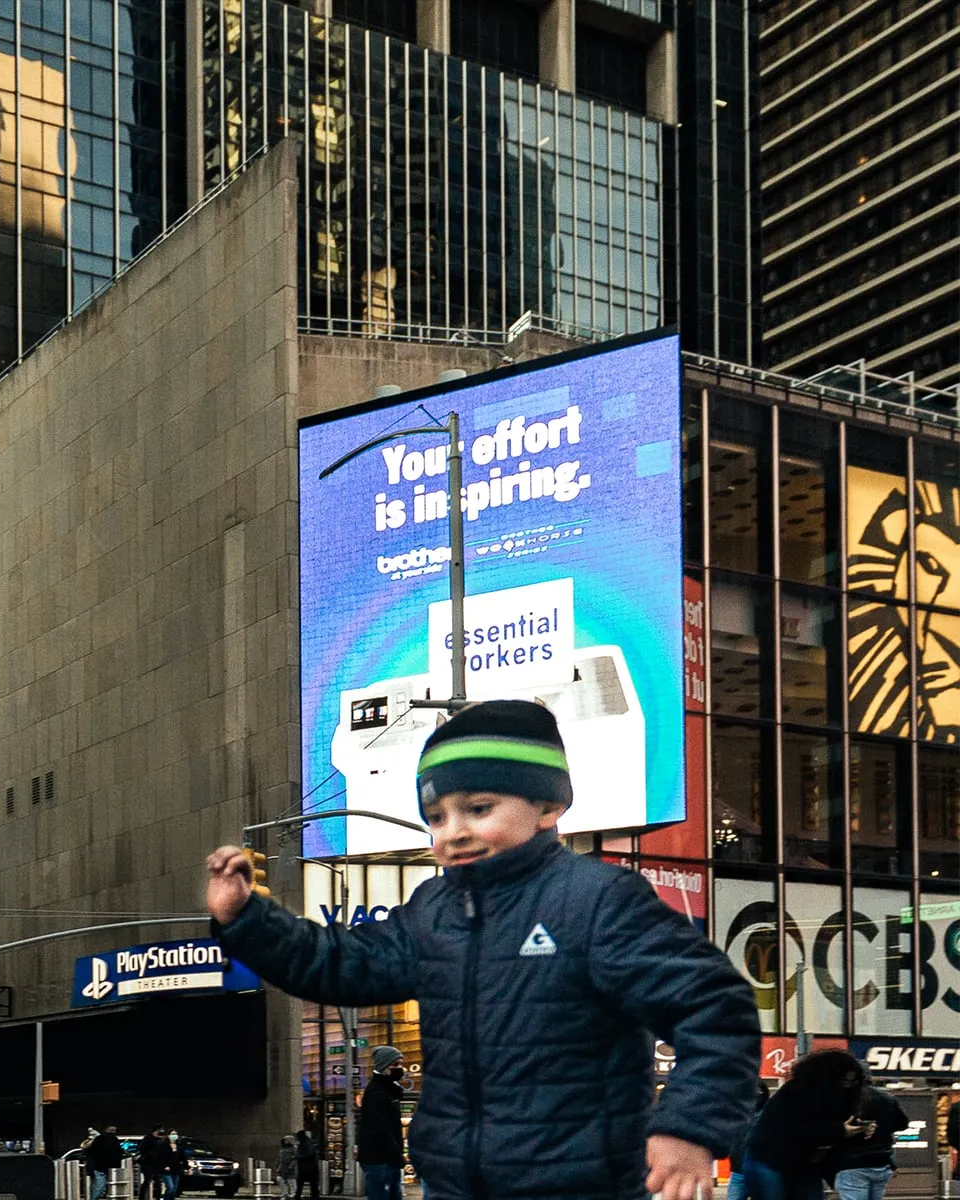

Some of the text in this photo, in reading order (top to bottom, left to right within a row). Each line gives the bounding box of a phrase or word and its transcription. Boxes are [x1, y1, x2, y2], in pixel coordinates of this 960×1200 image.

[472, 405, 582, 465] effort
[375, 492, 406, 532] is
[470, 643, 552, 671] orkers
[320, 904, 389, 925] VAC
[117, 943, 222, 977] PlayStation
[138, 977, 189, 990] THEATER
